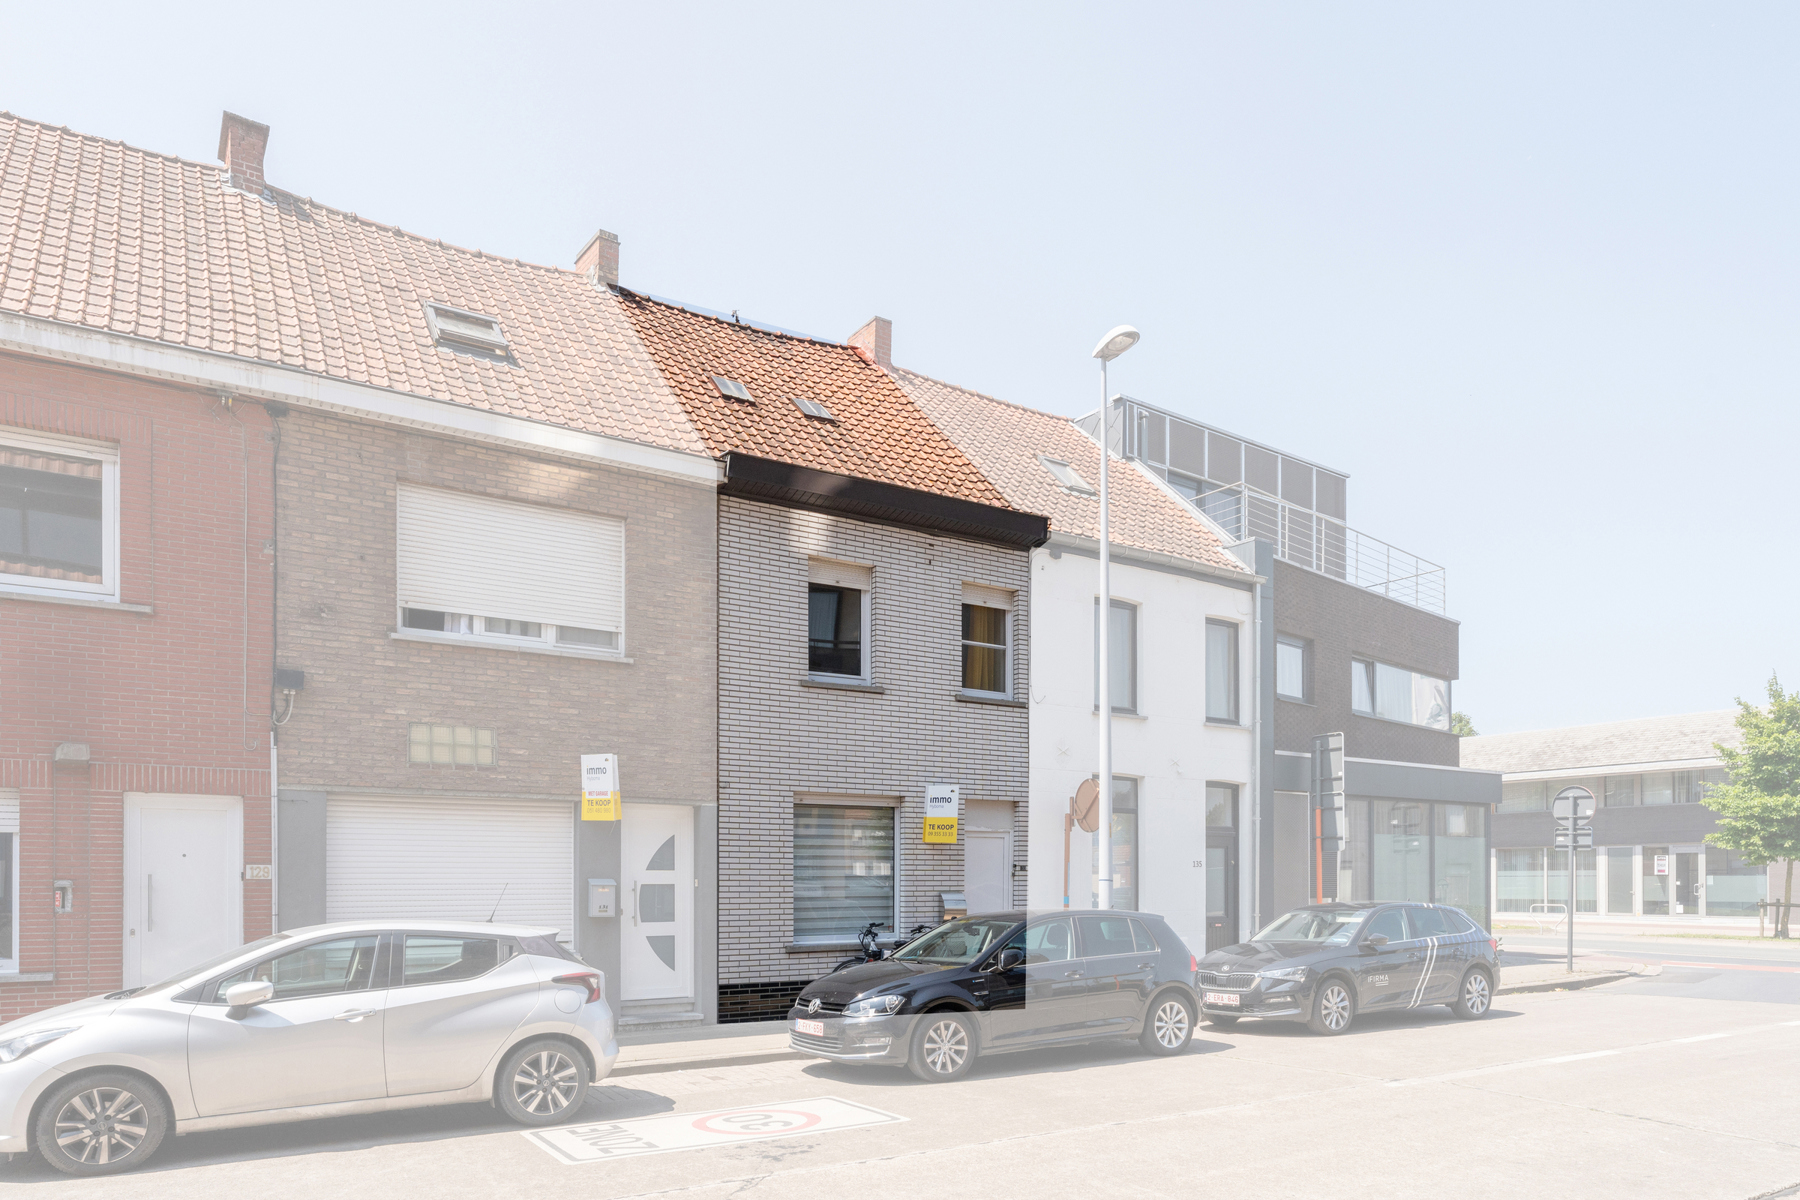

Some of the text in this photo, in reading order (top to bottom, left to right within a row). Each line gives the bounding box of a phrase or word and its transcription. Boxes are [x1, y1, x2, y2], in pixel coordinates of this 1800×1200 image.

[587, 765, 607, 775] immo
[930, 795, 952, 803] immo
[249, 866, 270, 878] 129
[722, 1113, 794, 1131] 30
[566, 1124, 660, 1154] ZONE
